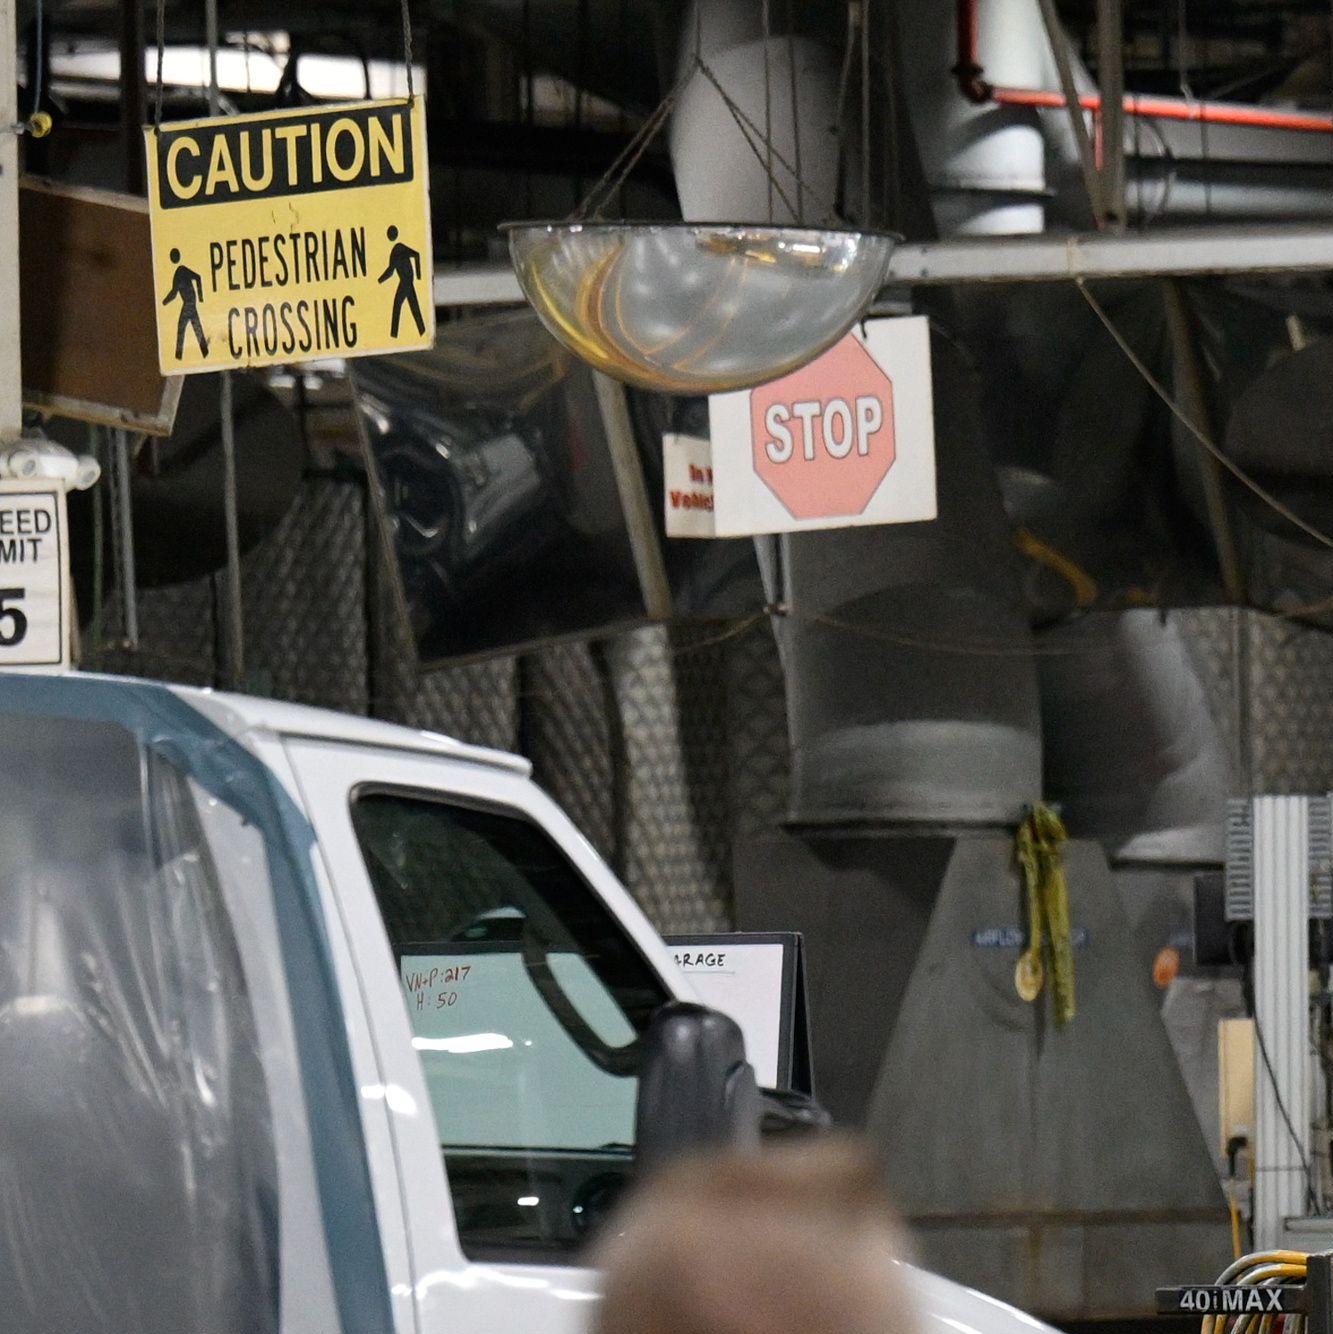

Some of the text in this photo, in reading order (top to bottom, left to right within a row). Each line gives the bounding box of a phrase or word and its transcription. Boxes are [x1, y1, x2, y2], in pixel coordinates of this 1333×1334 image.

[166, 113, 405, 199] CAUTION
[210, 226, 367, 292] PEDESTRIAN
[228, 295, 358, 359] CROSSING
[764, 395, 884, 464] STOP
[0, 509, 51, 535] EED
[0, 538, 42, 564] MIT
[436, 992, 457, 1009] 50
